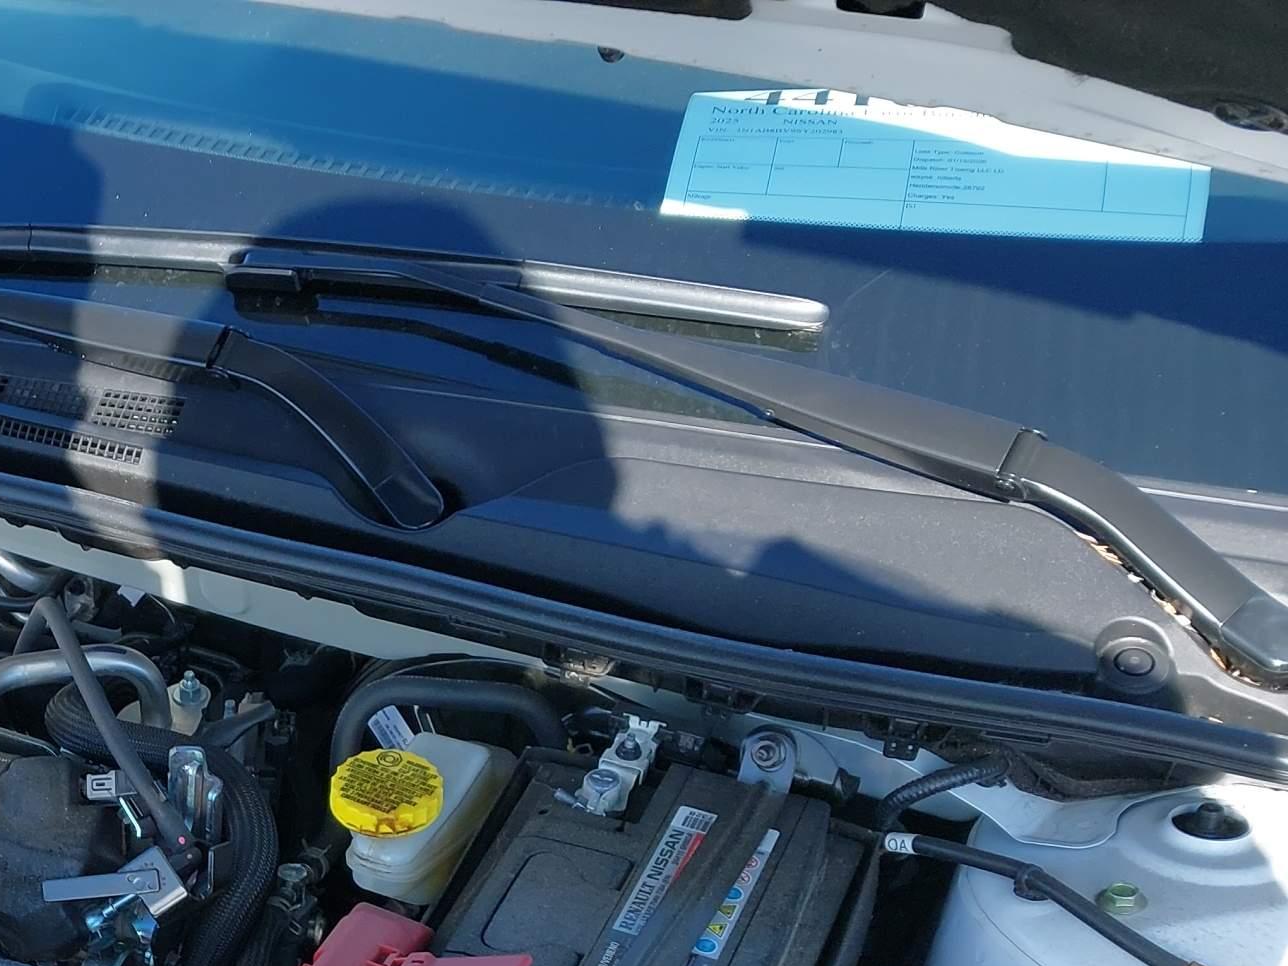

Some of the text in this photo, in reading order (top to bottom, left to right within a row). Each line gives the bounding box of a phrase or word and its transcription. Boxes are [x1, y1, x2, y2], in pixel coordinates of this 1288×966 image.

[712, 105, 765, 116] North
[618, 881, 657, 931] RENAULT
[646, 828, 685, 881] NISSAN
